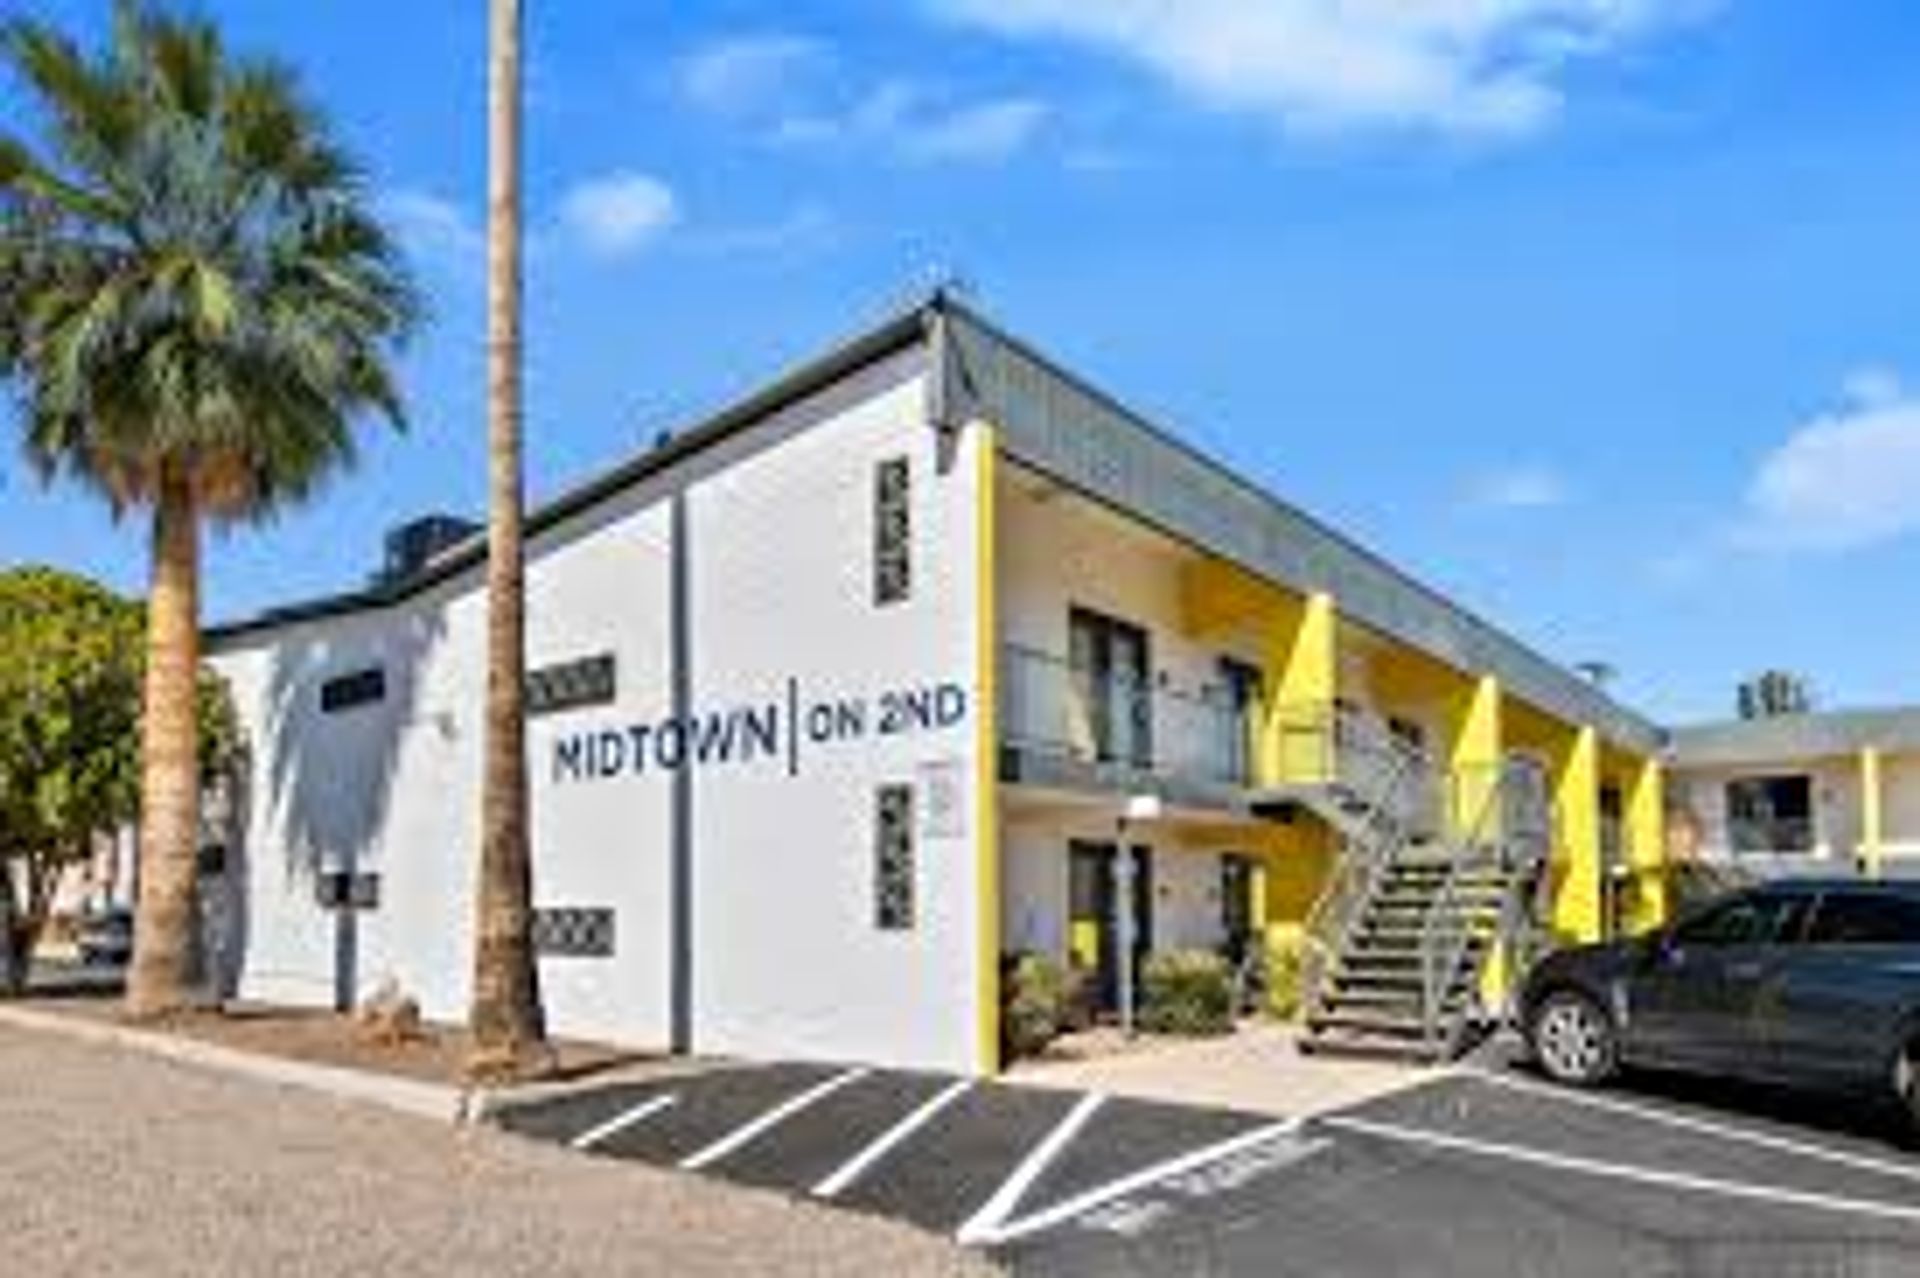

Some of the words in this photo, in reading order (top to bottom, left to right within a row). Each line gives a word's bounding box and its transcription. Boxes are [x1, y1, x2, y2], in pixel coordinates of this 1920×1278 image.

[553, 704, 778, 782] MIDTOWN
[809, 700, 863, 743] ON
[878, 684, 967, 735] 2ND
